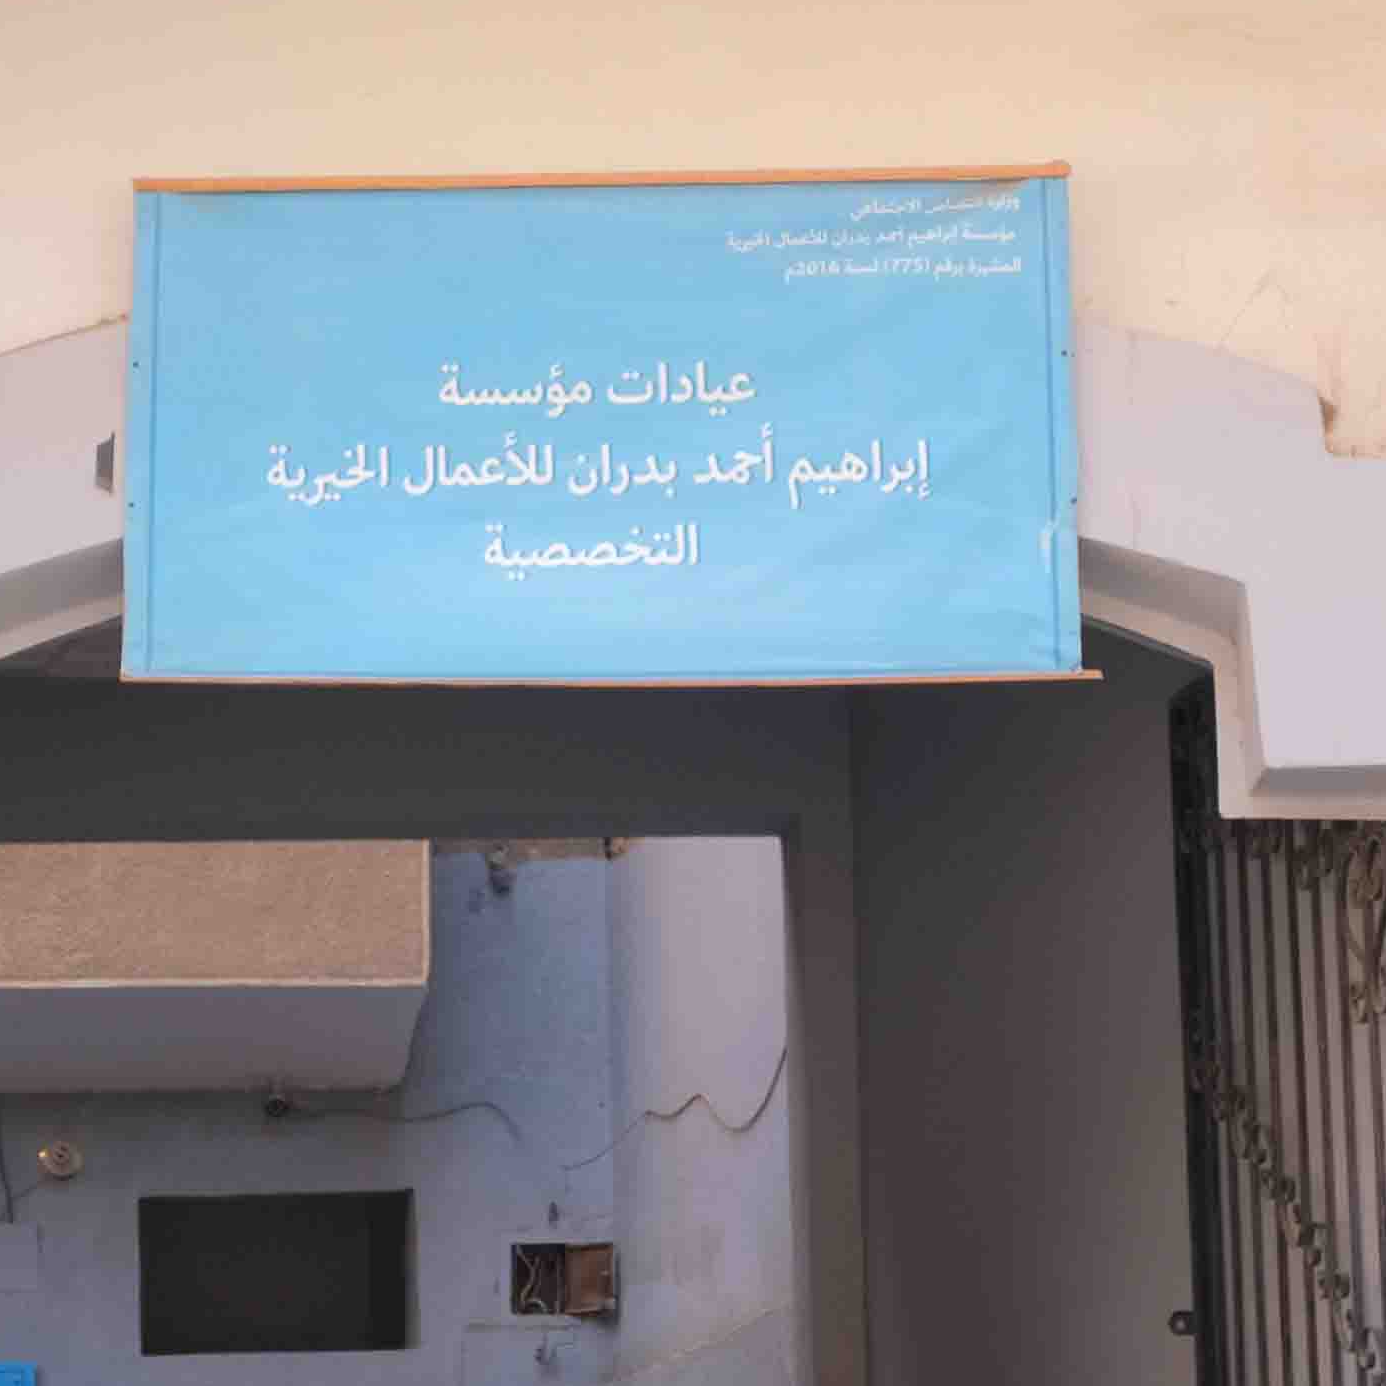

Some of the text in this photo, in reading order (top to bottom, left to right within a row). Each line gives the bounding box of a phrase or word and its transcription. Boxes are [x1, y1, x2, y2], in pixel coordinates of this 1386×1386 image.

[438, 361, 757, 417] عيادات مؤسسة
[265, 424, 931, 509] إبراهيم أحمد بدران للأعمال الخيرية
[482, 523, 701, 577] التخصصية
